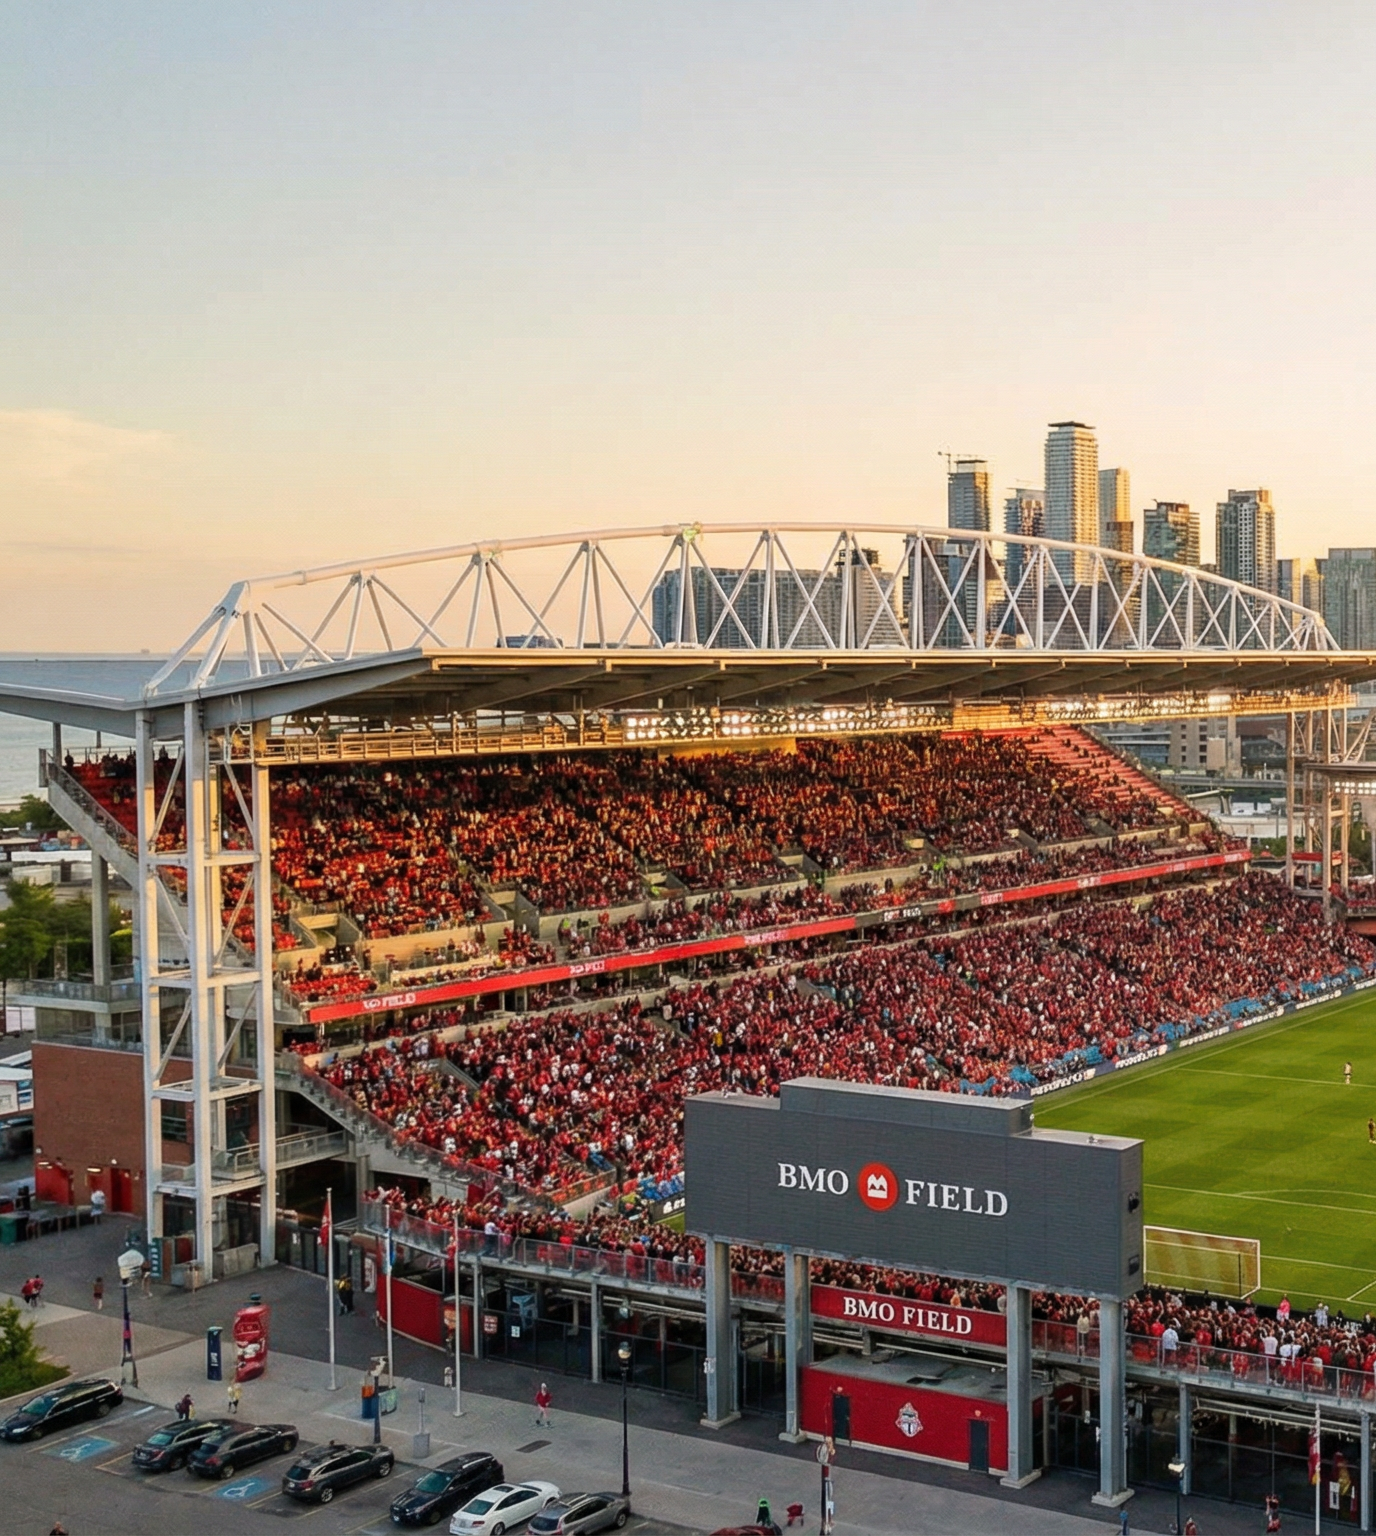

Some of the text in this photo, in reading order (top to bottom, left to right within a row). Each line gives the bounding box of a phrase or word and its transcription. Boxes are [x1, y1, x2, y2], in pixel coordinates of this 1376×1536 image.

[777, 1162, 1008, 1217] BMO FIELD
[843, 1296, 972, 1335] BMO FIELD
